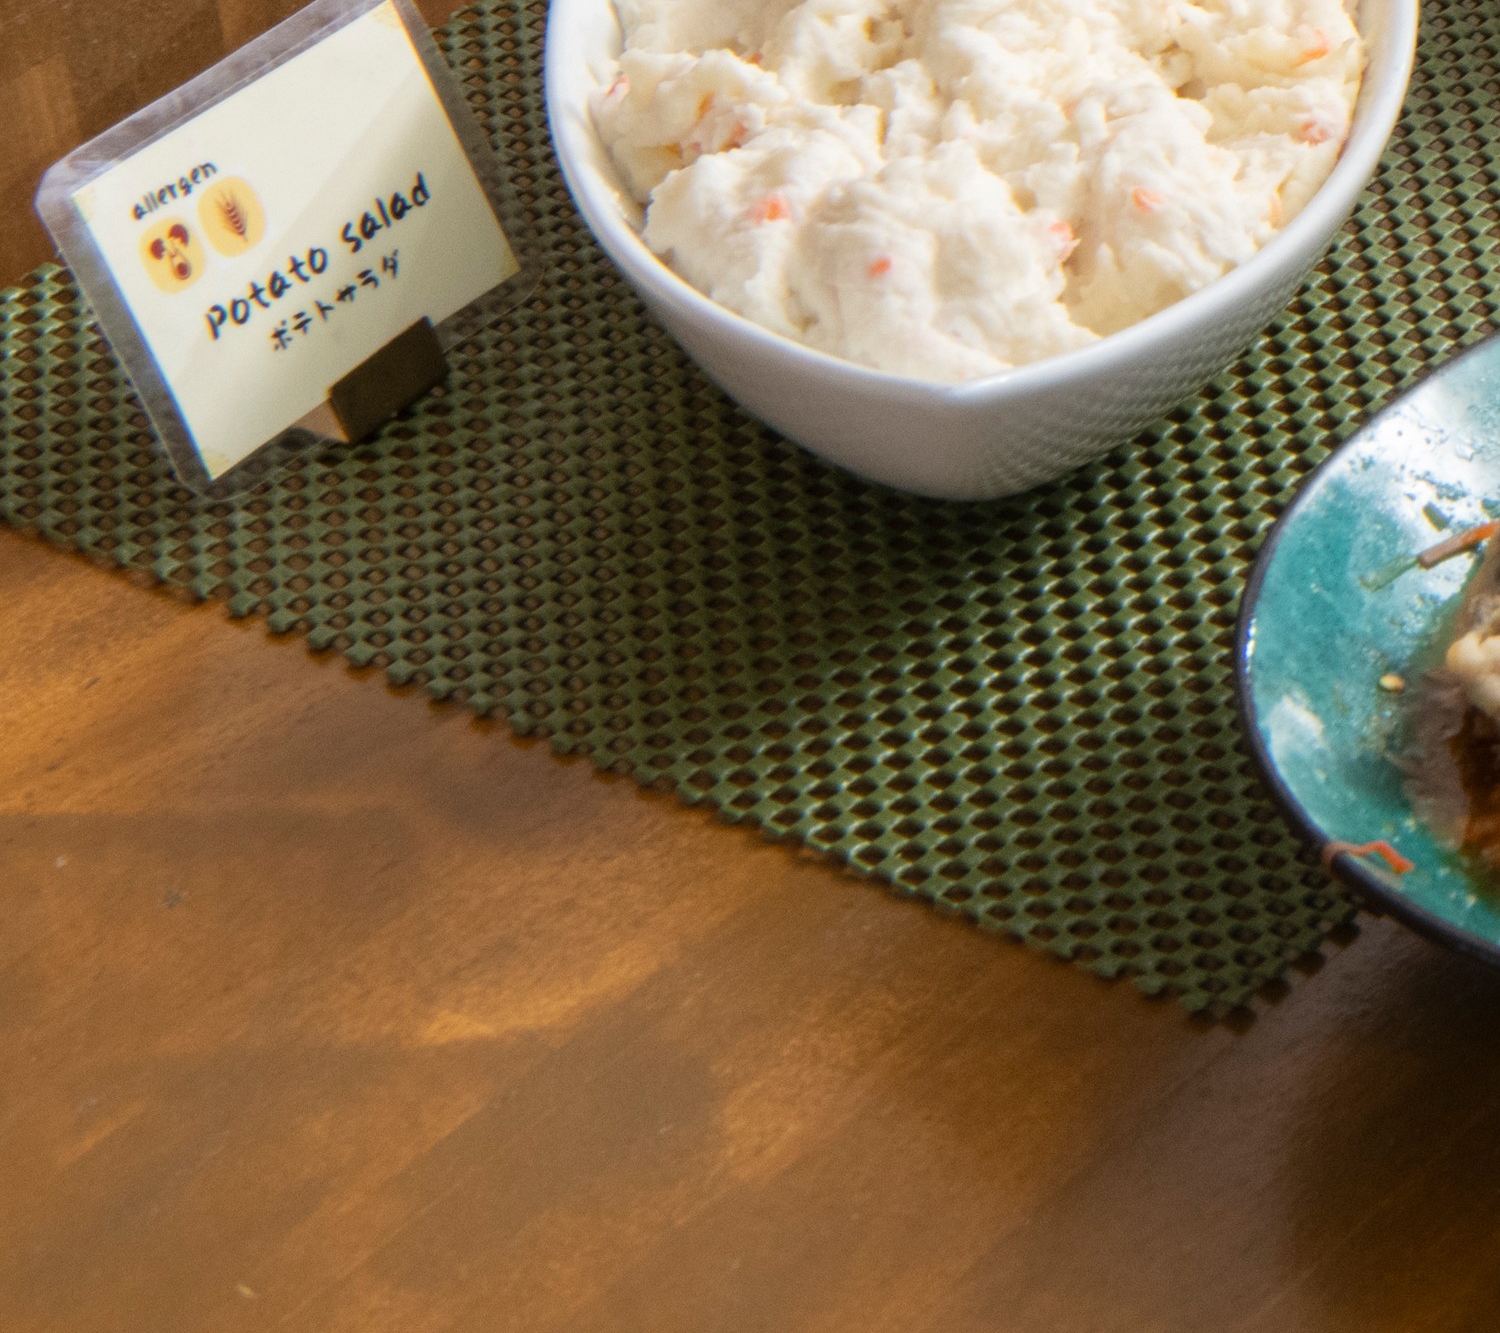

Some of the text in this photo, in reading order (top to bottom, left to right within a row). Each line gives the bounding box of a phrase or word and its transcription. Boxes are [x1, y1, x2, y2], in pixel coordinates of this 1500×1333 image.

[131, 160, 218, 222] allergen
[204, 170, 432, 341] Potato salad
[270, 247, 400, 352] ポテトサラダ
